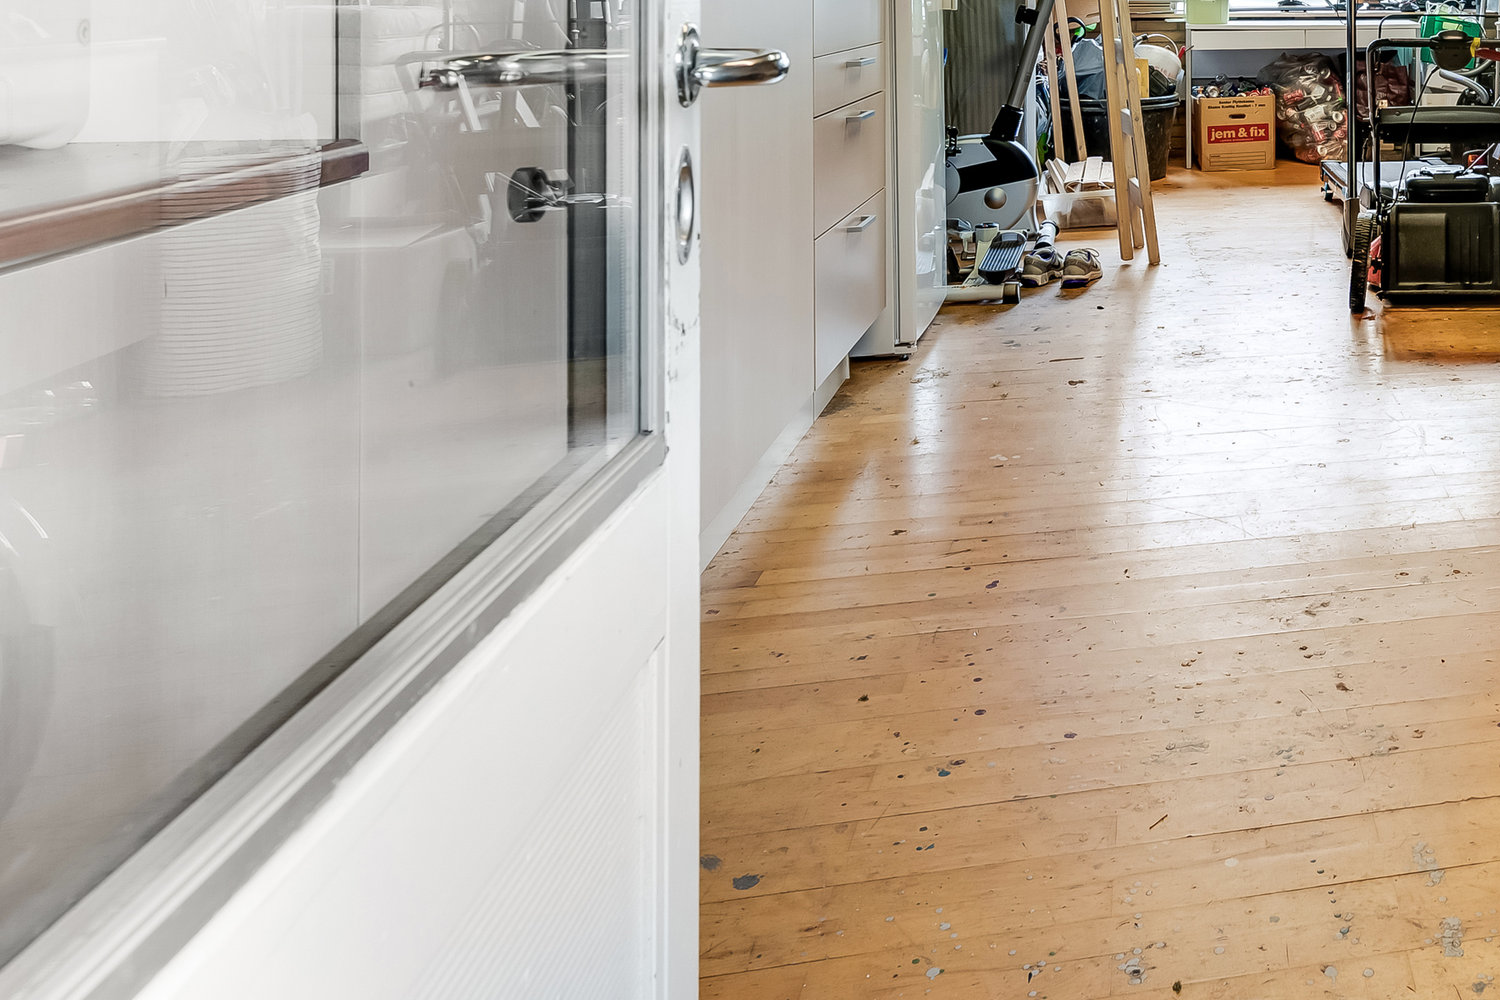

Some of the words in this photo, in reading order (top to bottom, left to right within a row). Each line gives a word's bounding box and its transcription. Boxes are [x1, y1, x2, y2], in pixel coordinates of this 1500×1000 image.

[1210, 128, 1236, 142] jem
[1237, 127, 1248, 138] &
[1249, 126, 1266, 137] fix
